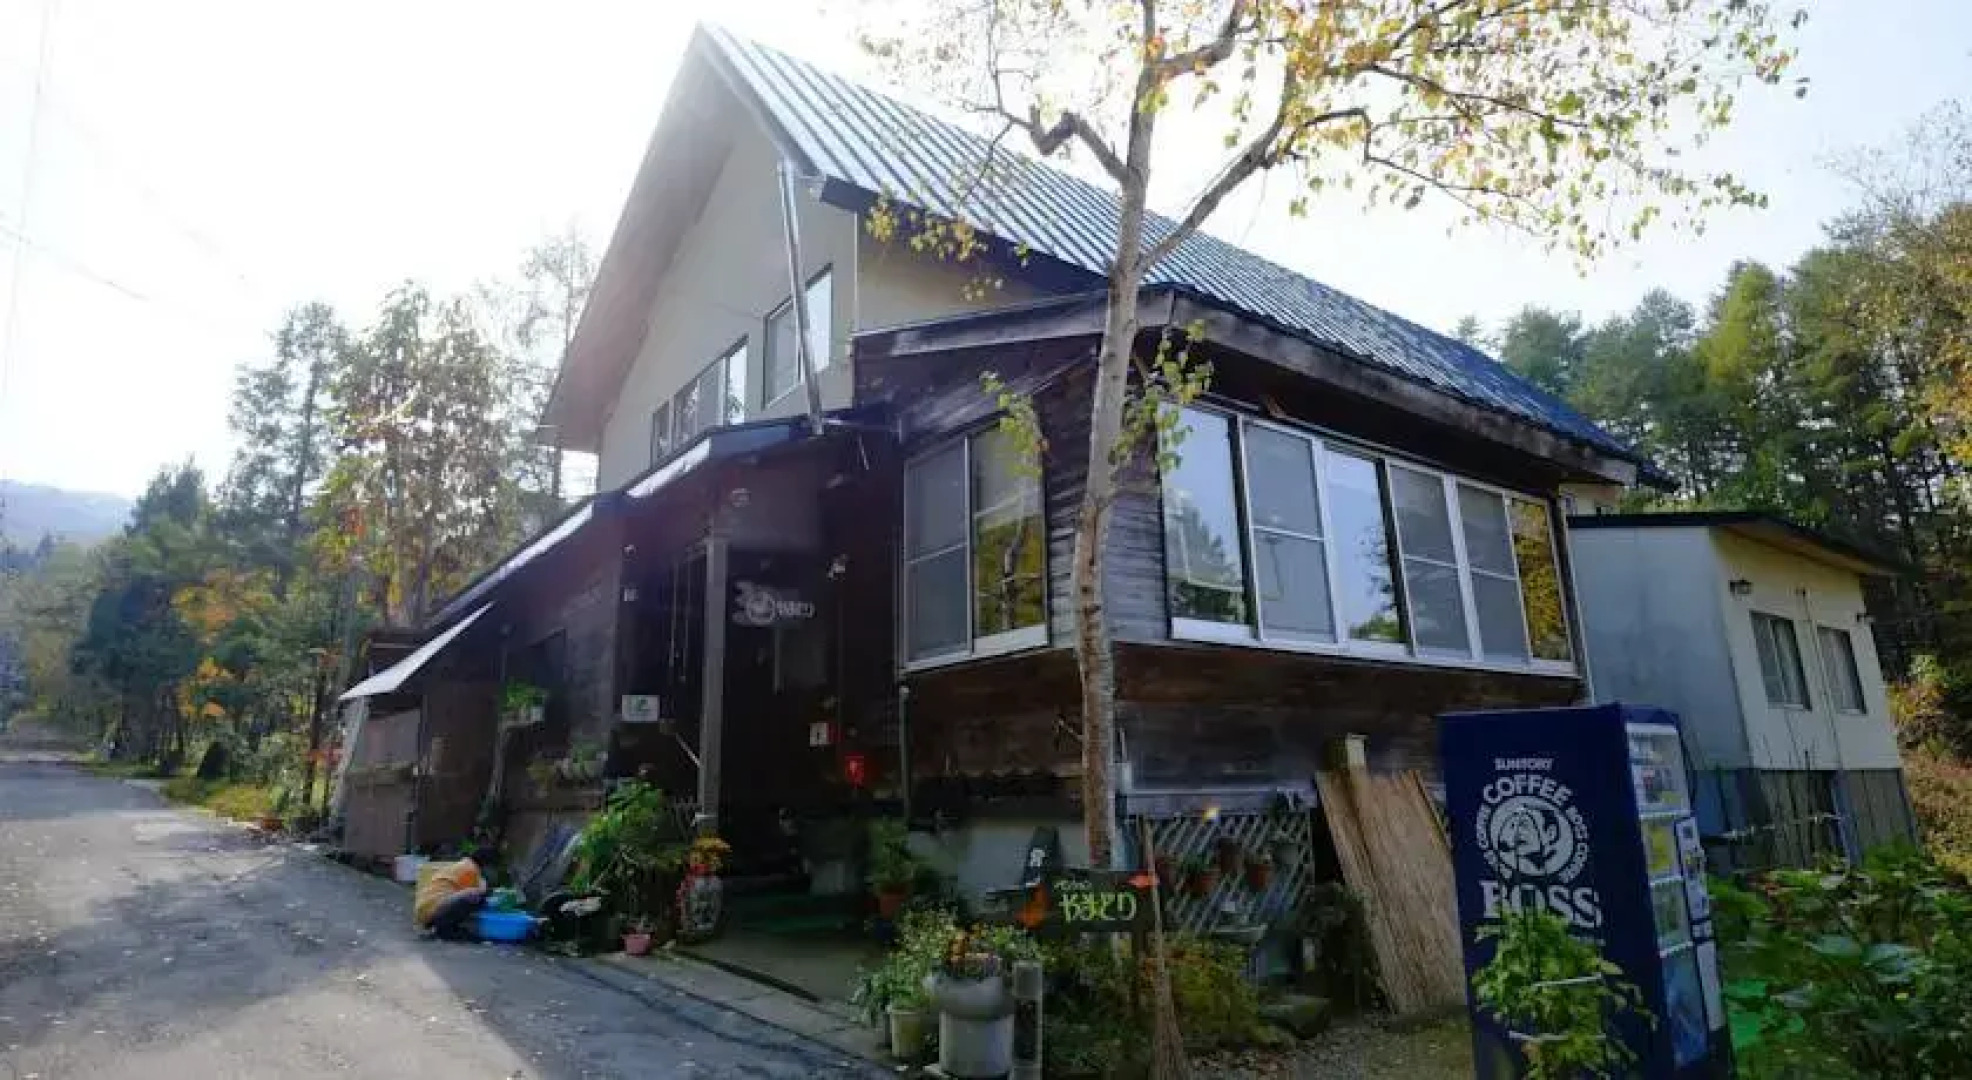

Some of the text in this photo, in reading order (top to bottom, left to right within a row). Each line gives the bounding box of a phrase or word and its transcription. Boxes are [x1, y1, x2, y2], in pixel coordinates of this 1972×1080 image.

[1495, 758, 1554, 770] SUNTORY
[1483, 774, 1573, 805] COFFEE
[1058, 891, 1137, 923] やまどり
[1479, 880, 1602, 928] BOSS
